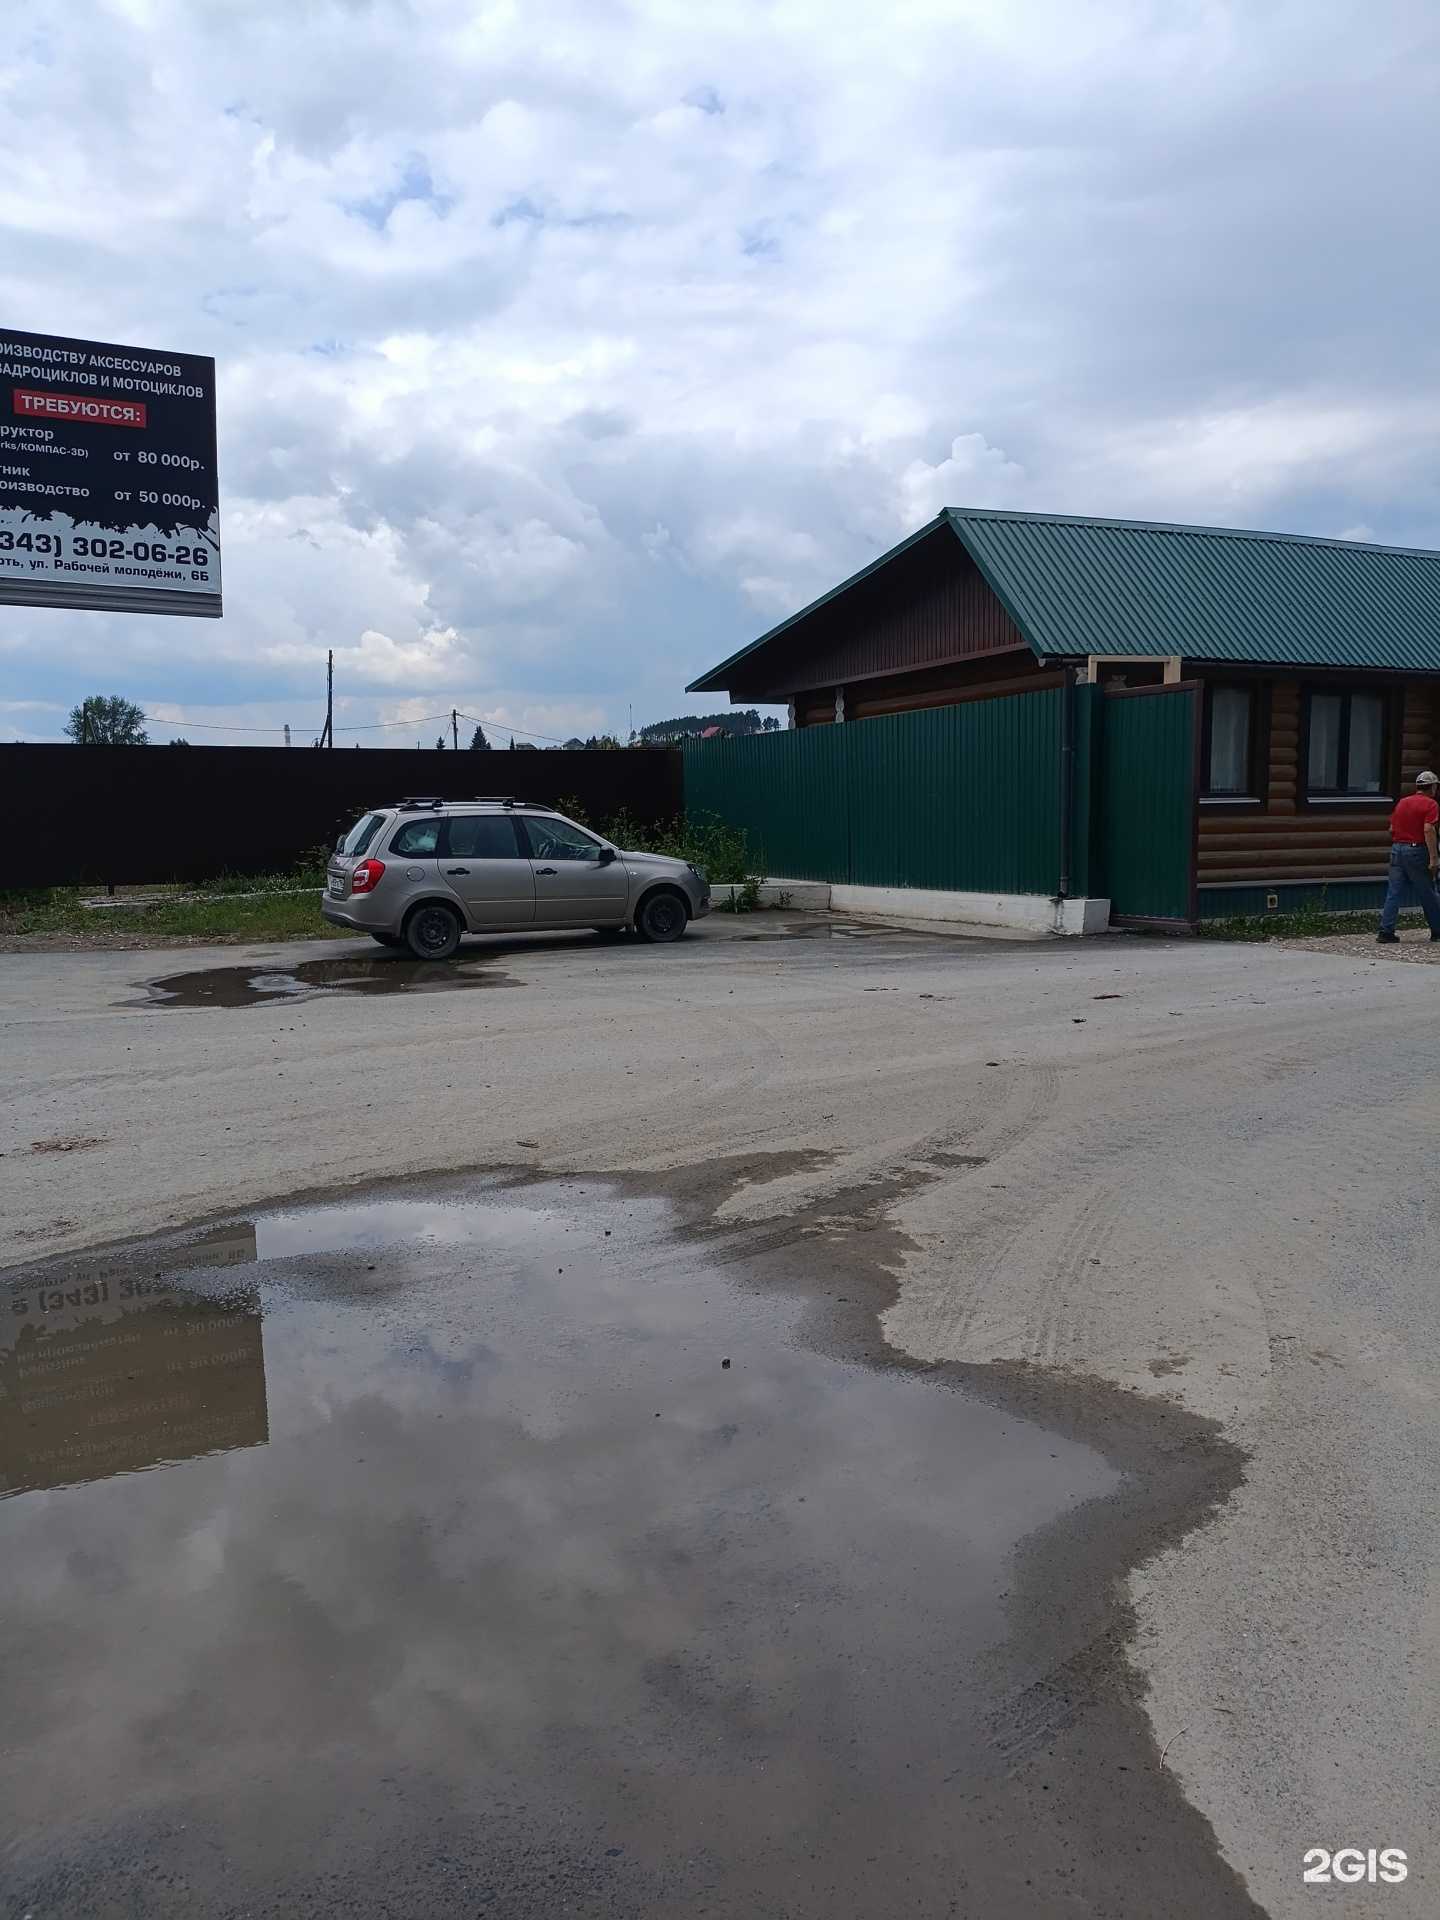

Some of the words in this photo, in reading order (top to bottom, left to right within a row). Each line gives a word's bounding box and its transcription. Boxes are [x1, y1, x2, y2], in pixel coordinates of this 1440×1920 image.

[89, 355, 182, 377] АКСЕССУАРОВ
[0, 363, 98, 386] АДРОЦИКЛОВ
[100, 375, 110, 387] И
[112, 377, 204, 398] МОТОЦИКЛОВ
[21, 395, 141, 421] ТРЕБУЮТСЯ:
[0, 425, 54, 442] руктор
[113, 451, 131, 462] от
[137, 451, 158, 465] 80
[161, 453, 205, 471] 000р.
[0, 480, 90, 497] оизводство
[114, 491, 132, 501] от
[139, 490, 159, 504] 50
[162, 493, 206, 510] 000р.
[0, 530, 62, 558] 343)
[72, 536, 209, 567] 302-06-26
[29, 559, 49, 571] ул.
[54, 559, 110, 574] Рабочей
[114, 565, 186, 581] молодёжи,
